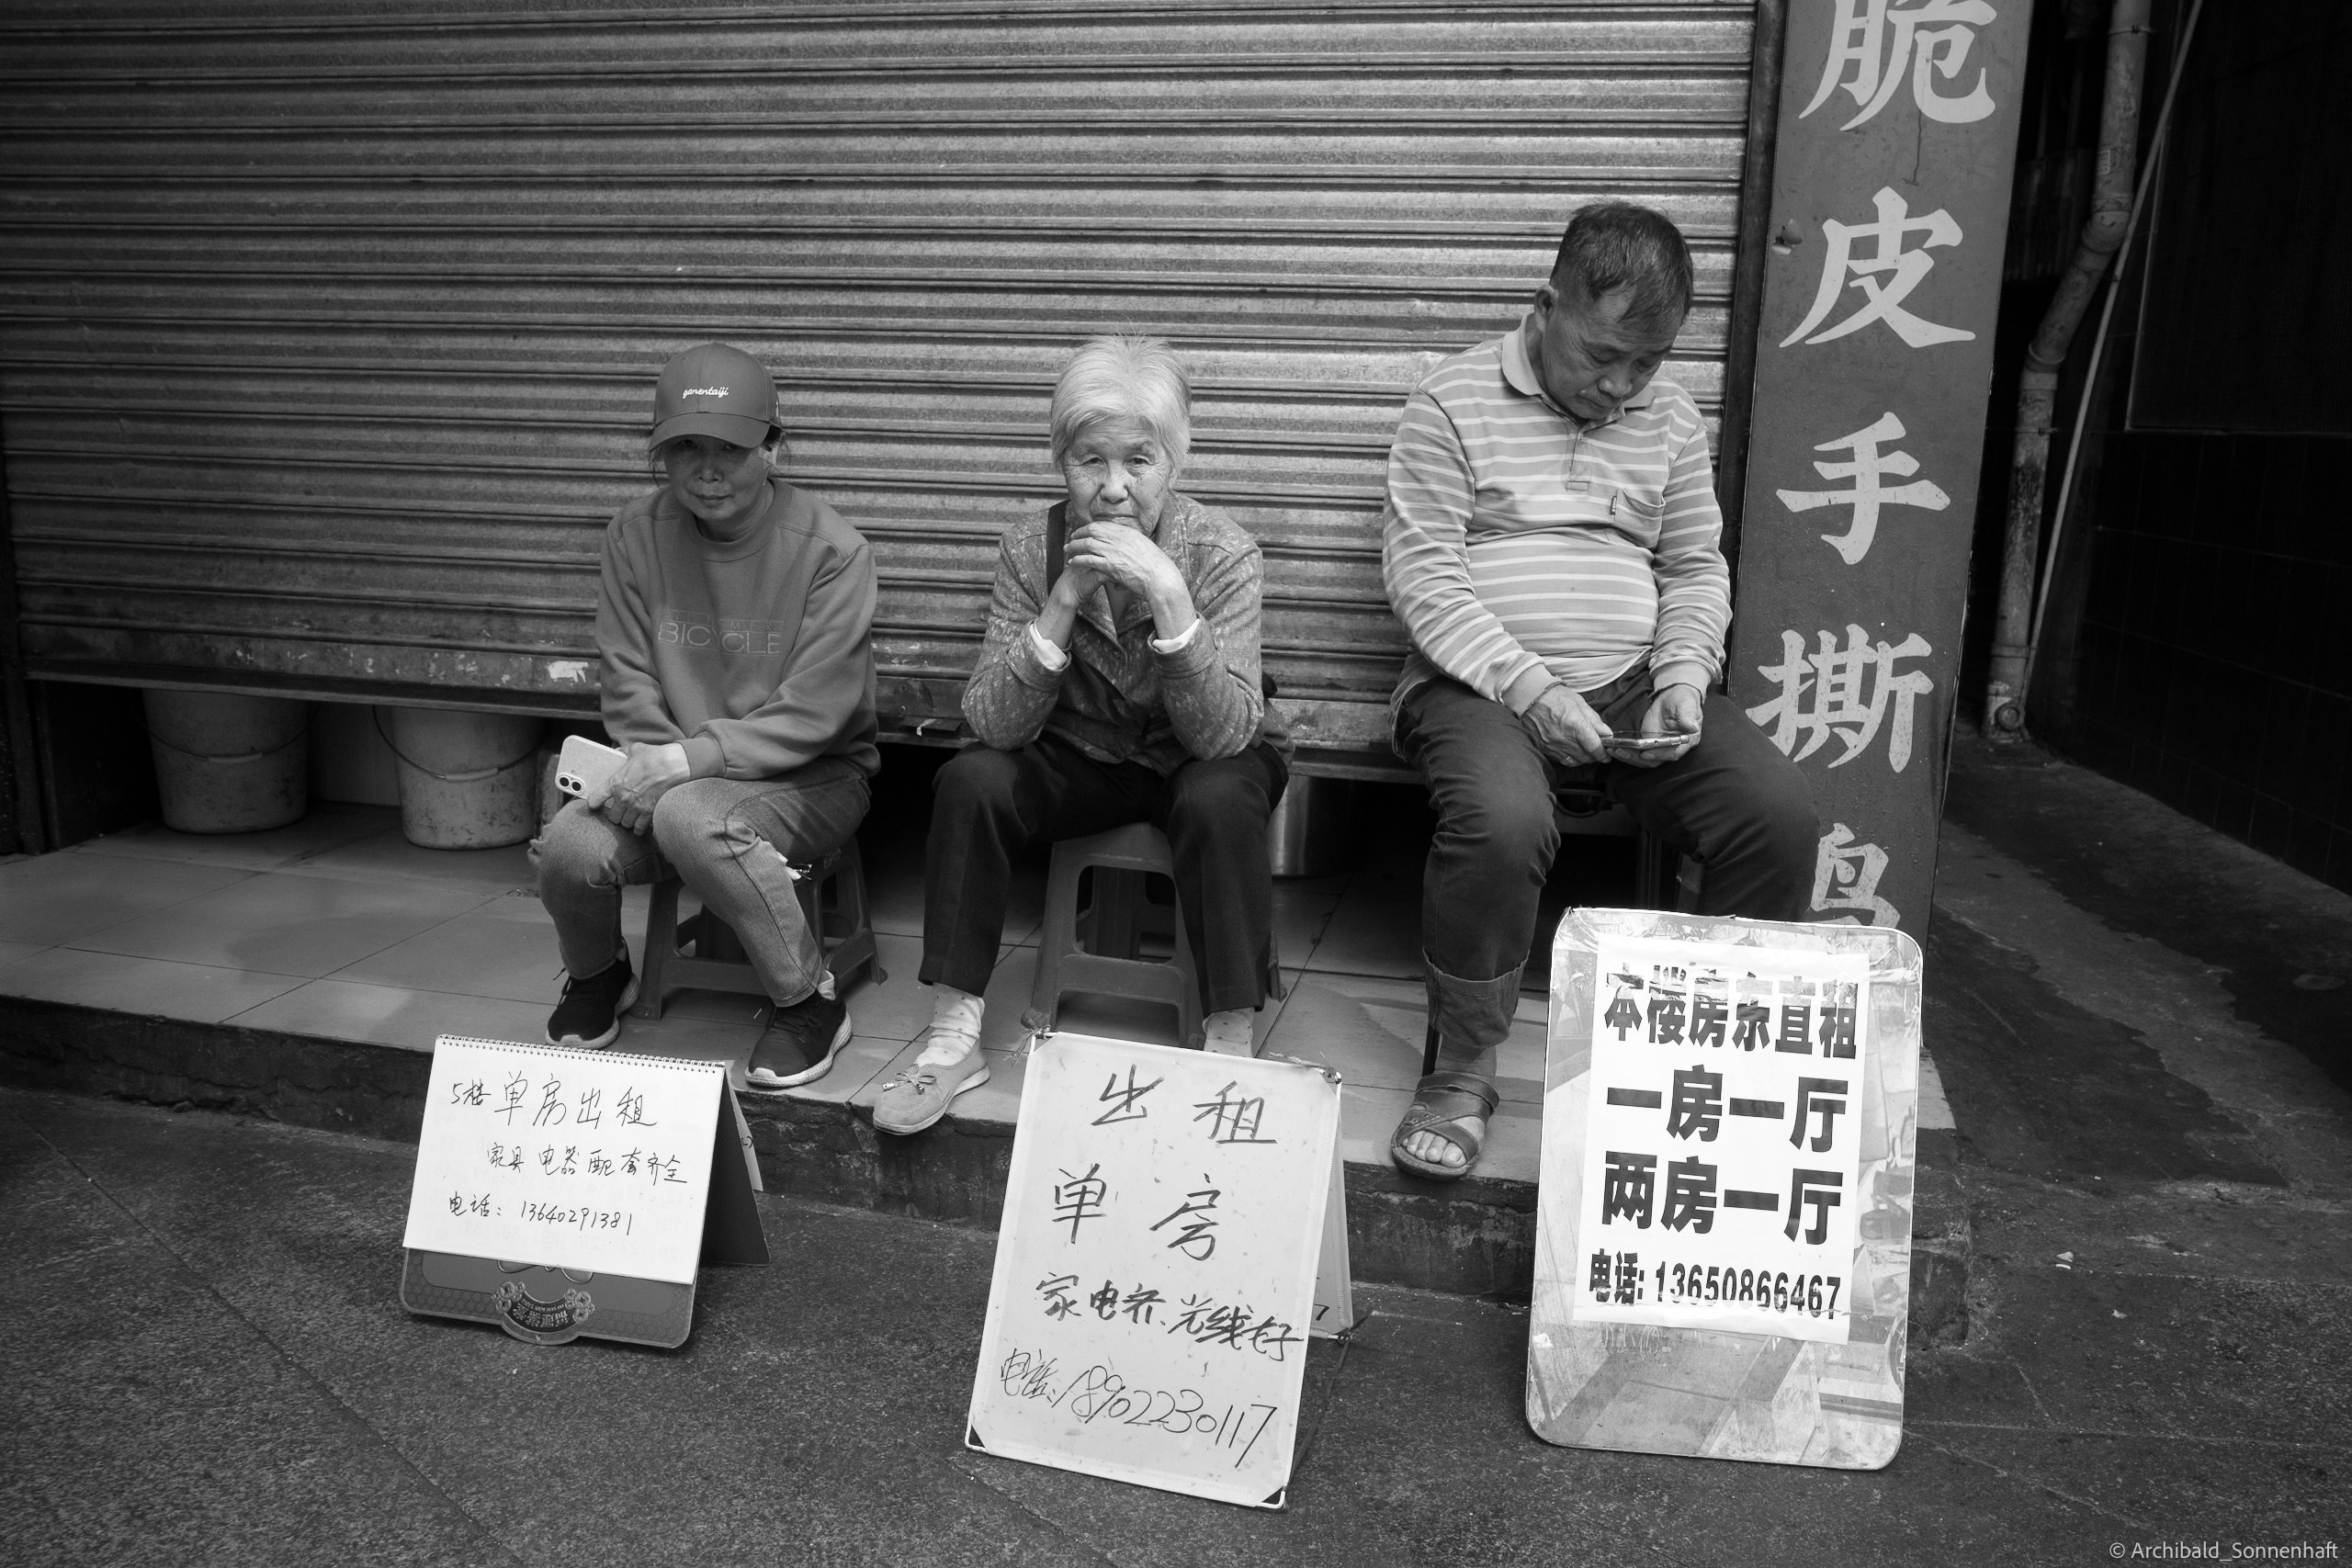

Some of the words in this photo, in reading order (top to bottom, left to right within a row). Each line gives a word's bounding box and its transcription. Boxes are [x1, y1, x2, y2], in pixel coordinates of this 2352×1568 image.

[1091, 1064, 1277, 1145] 出租
[1606, 1064, 1849, 1154] 一房一厅
[1052, 1163, 1221, 1260] 单房
[1601, 1150, 1843, 1247] 两房一厅
